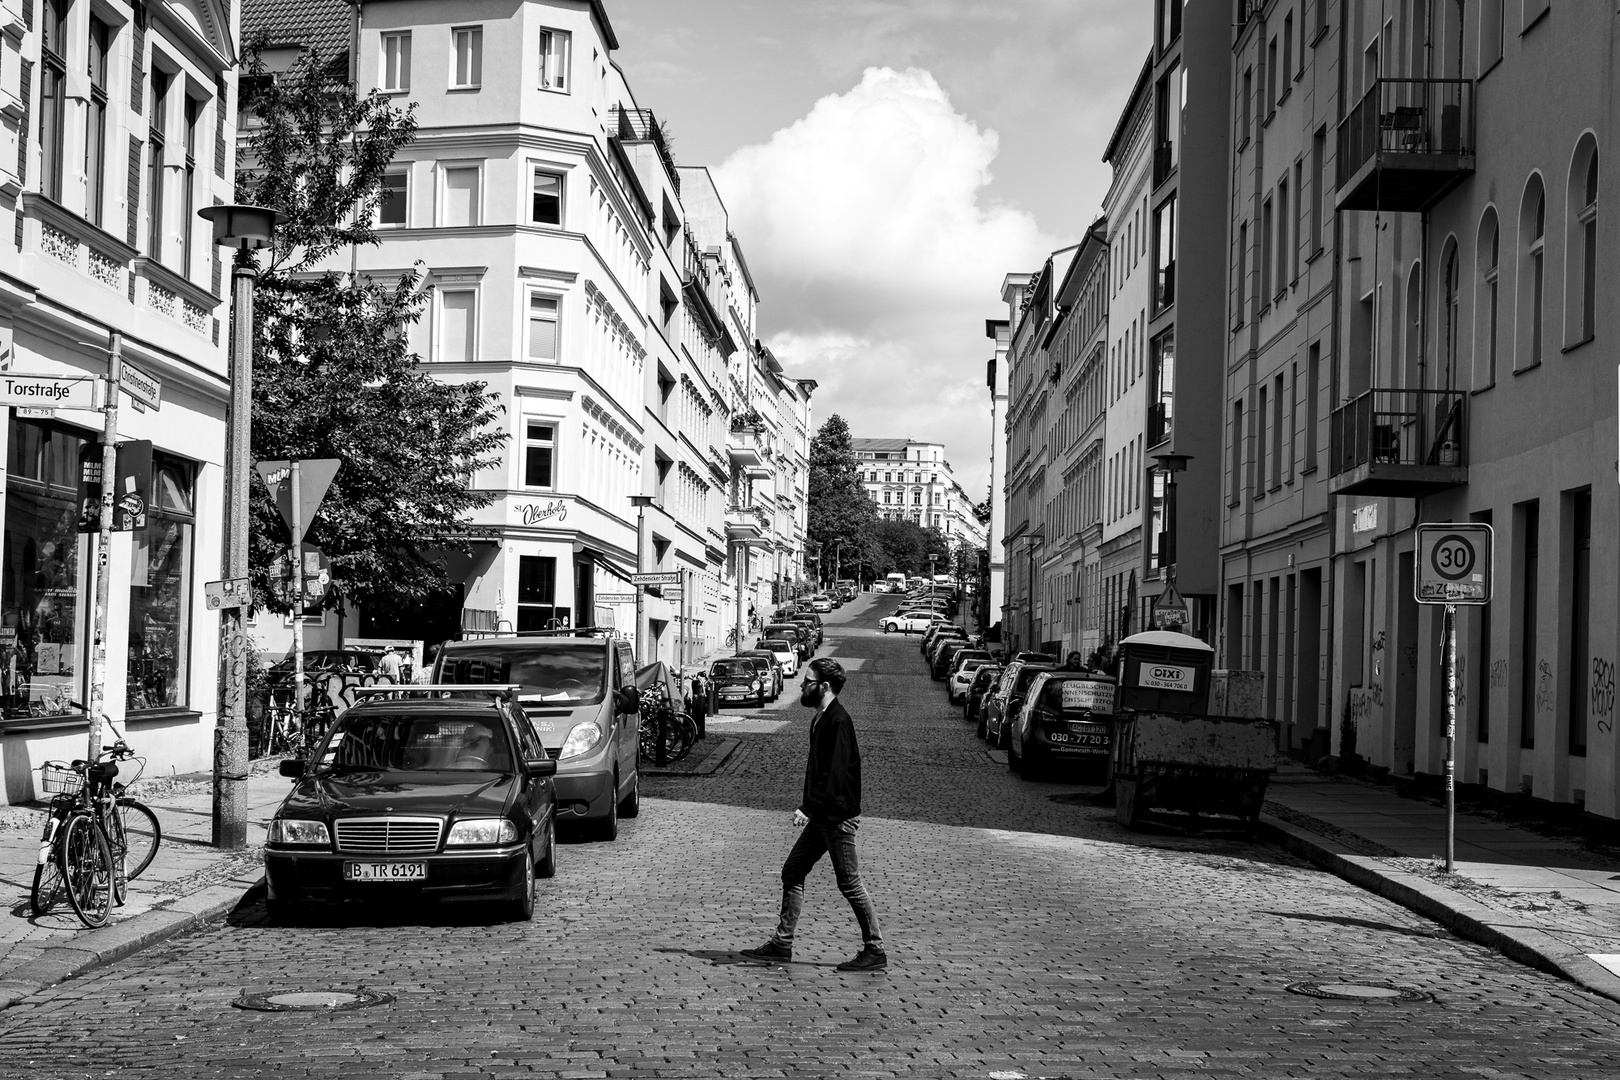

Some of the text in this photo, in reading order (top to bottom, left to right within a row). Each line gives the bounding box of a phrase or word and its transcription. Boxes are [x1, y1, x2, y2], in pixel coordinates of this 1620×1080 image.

[5, 380, 70, 400] Torstraße
[522, 500, 567, 525] Oberholz
[1440, 547, 1466, 568] 30
[1051, 732, 1069, 742] 030
[1076, 734, 1087, 743] 77
[1090, 735, 1101, 744] 20
[1103, 736, 1110, 745] 3
[353, 864, 424, 877] B TR 6191
